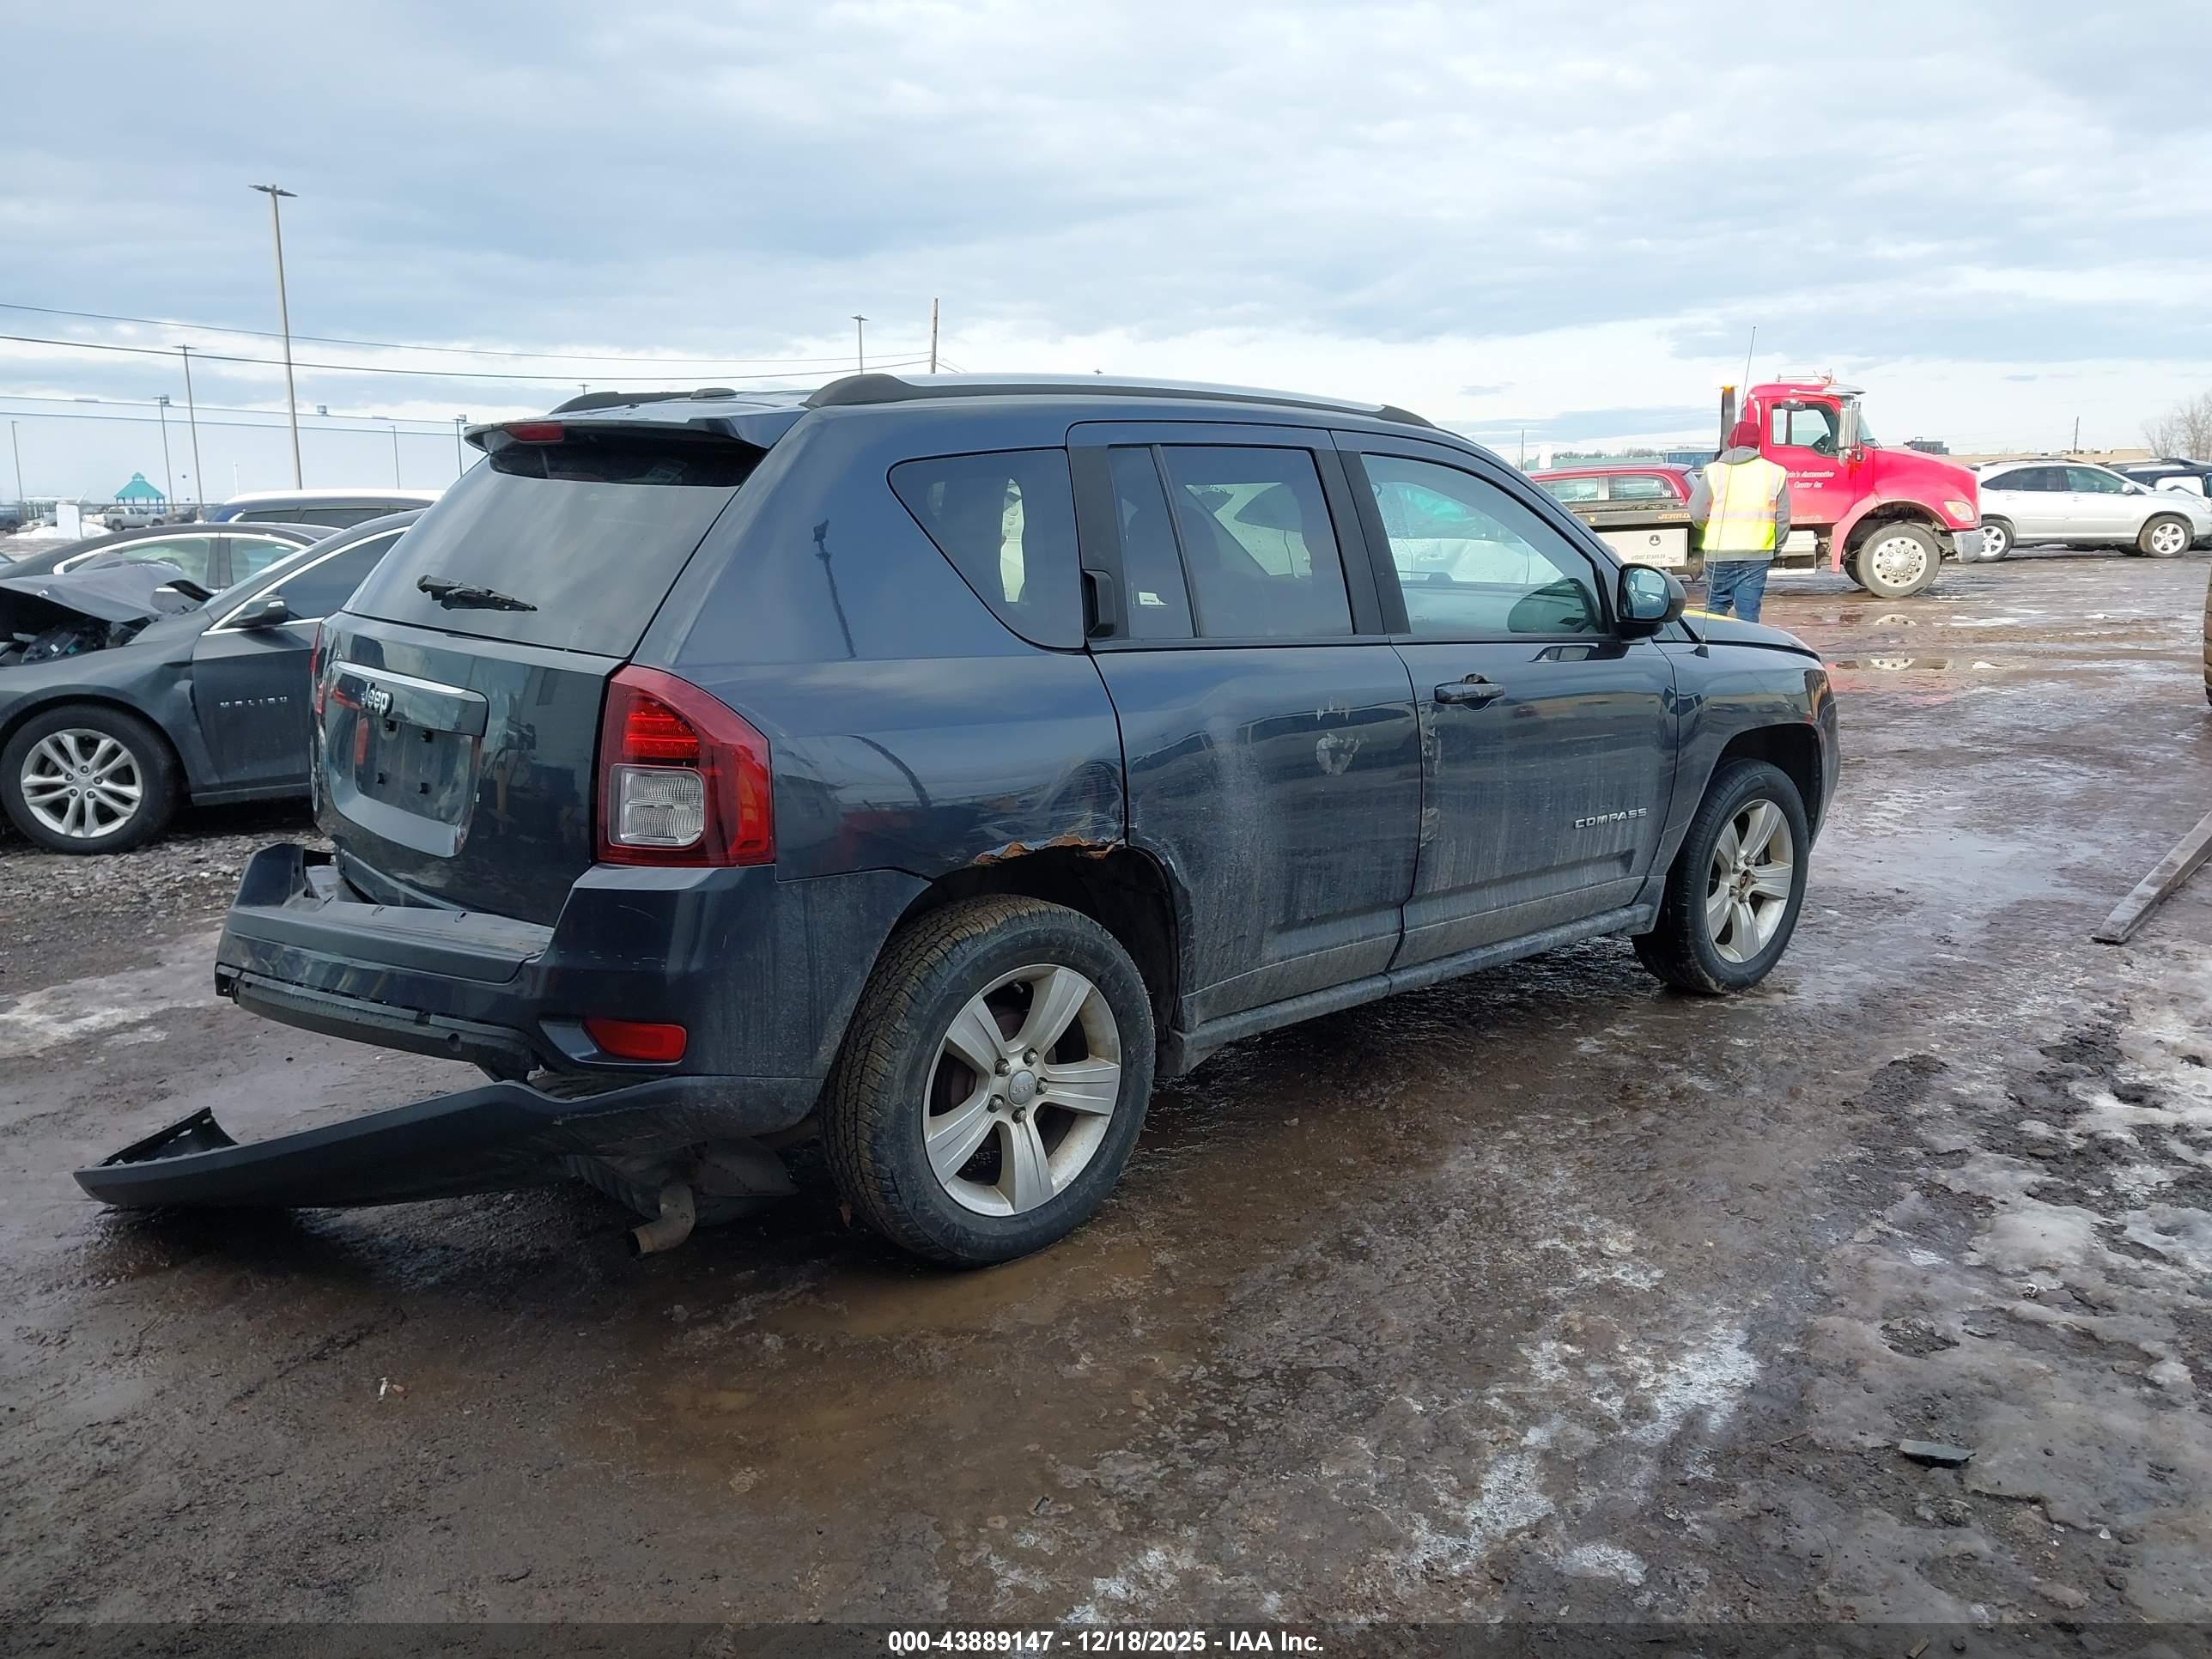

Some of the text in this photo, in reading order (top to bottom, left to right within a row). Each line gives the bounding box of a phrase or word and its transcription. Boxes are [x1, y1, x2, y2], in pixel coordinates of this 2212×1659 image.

[219, 696, 289, 708] MALIBU
[364, 682, 392, 715] Jeep
[1573, 807, 1648, 829] COMPASS
